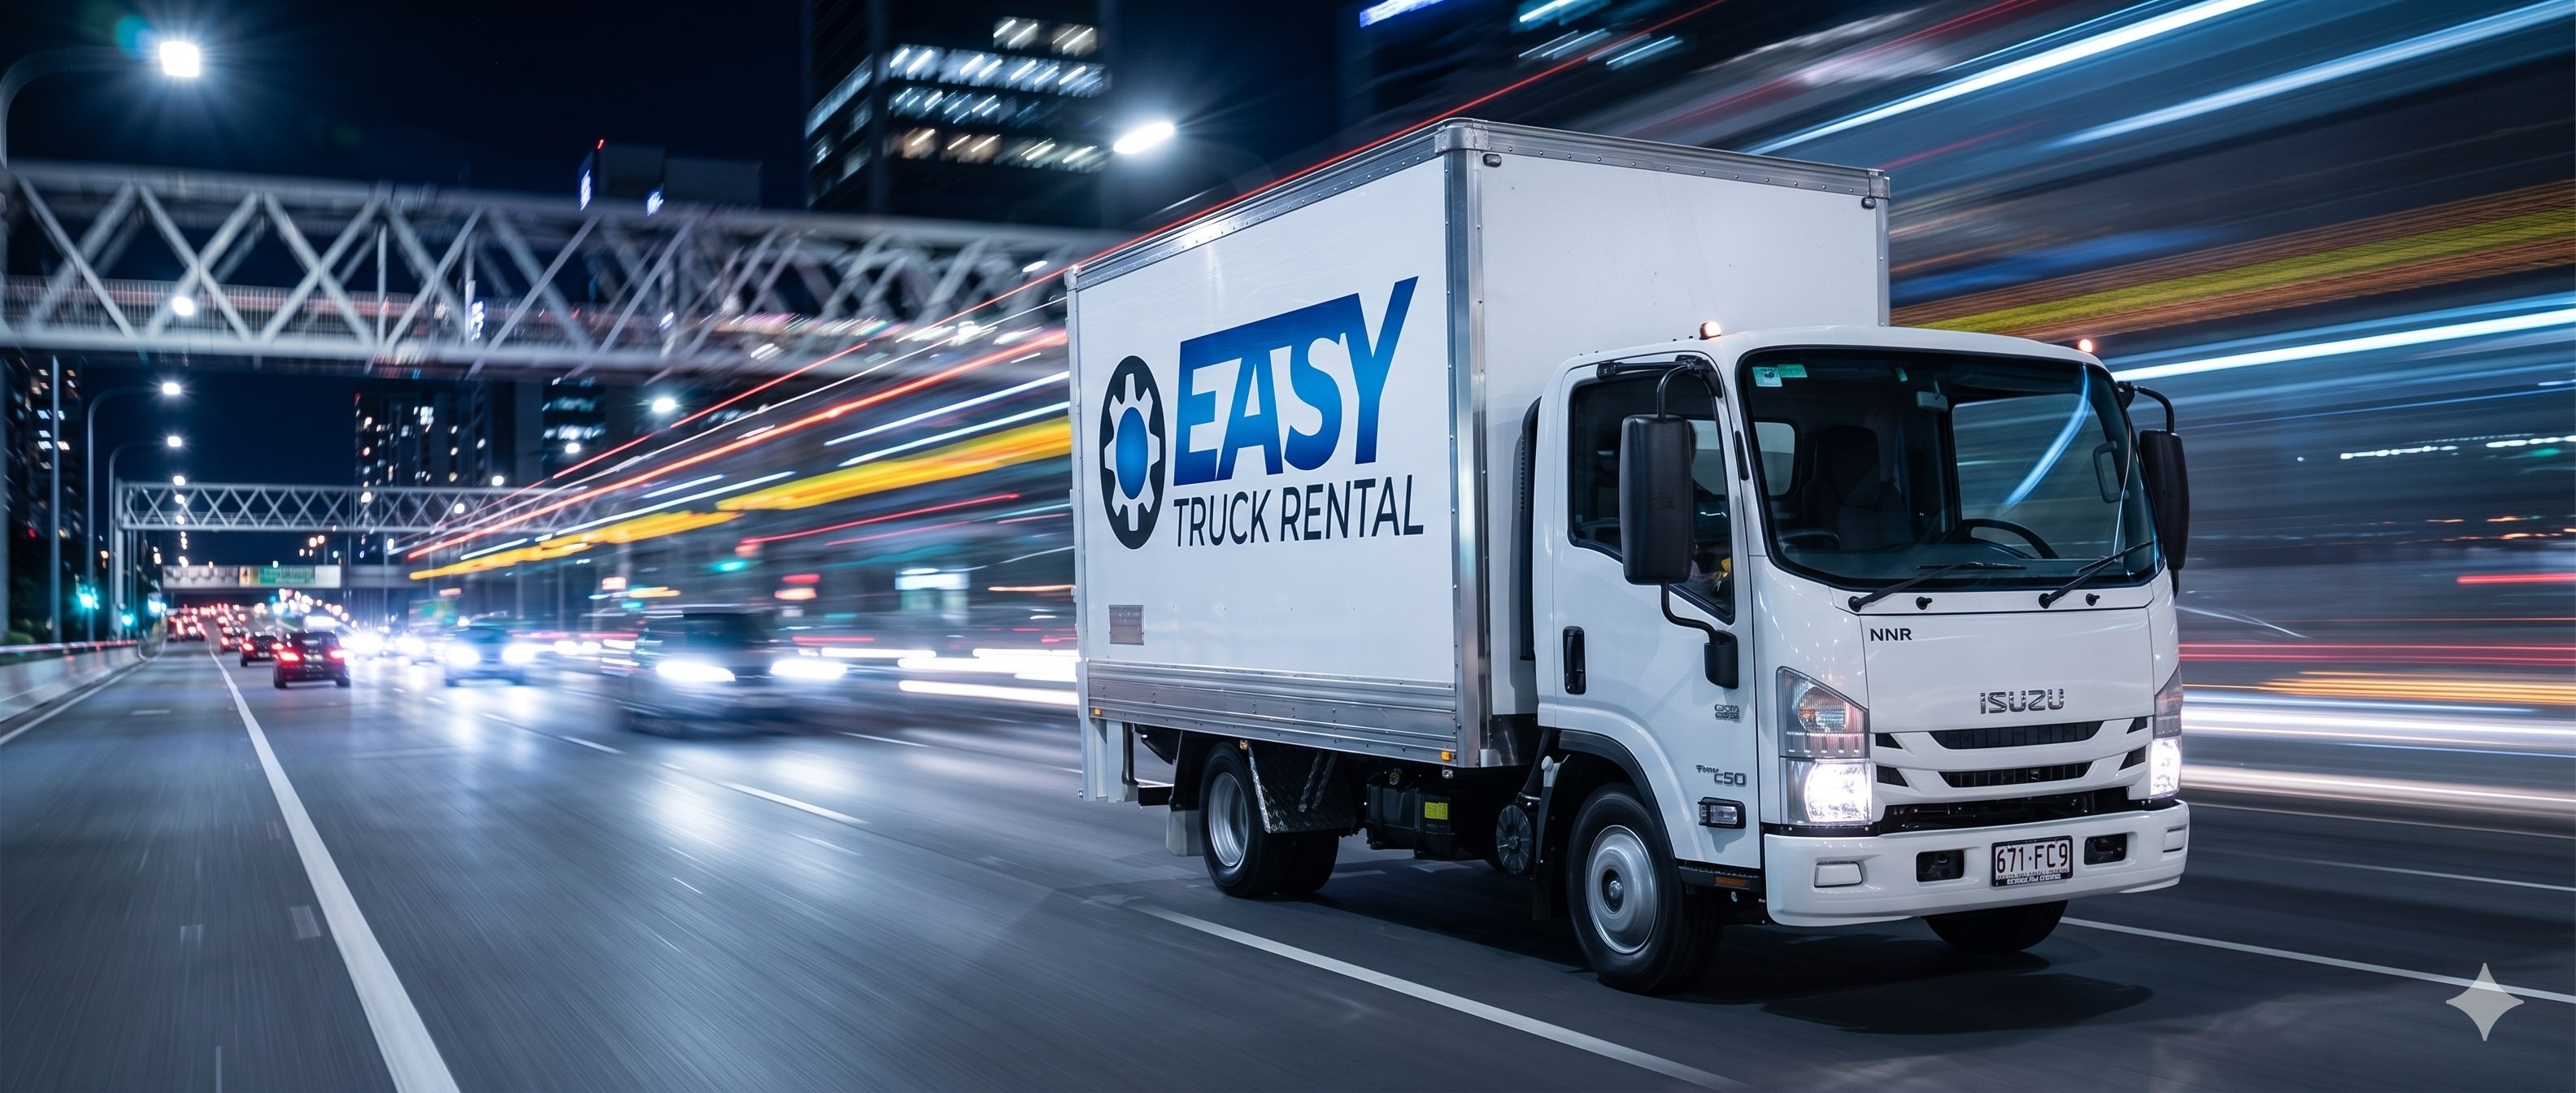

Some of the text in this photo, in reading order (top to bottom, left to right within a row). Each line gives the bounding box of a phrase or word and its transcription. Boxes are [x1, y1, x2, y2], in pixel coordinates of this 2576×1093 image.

[1173, 276, 1419, 486] EASY
[1173, 474, 1424, 546] TRUCK RENTAL
[1869, 628, 1913, 642] NNR
[1979, 688, 2065, 715] ISUZU
